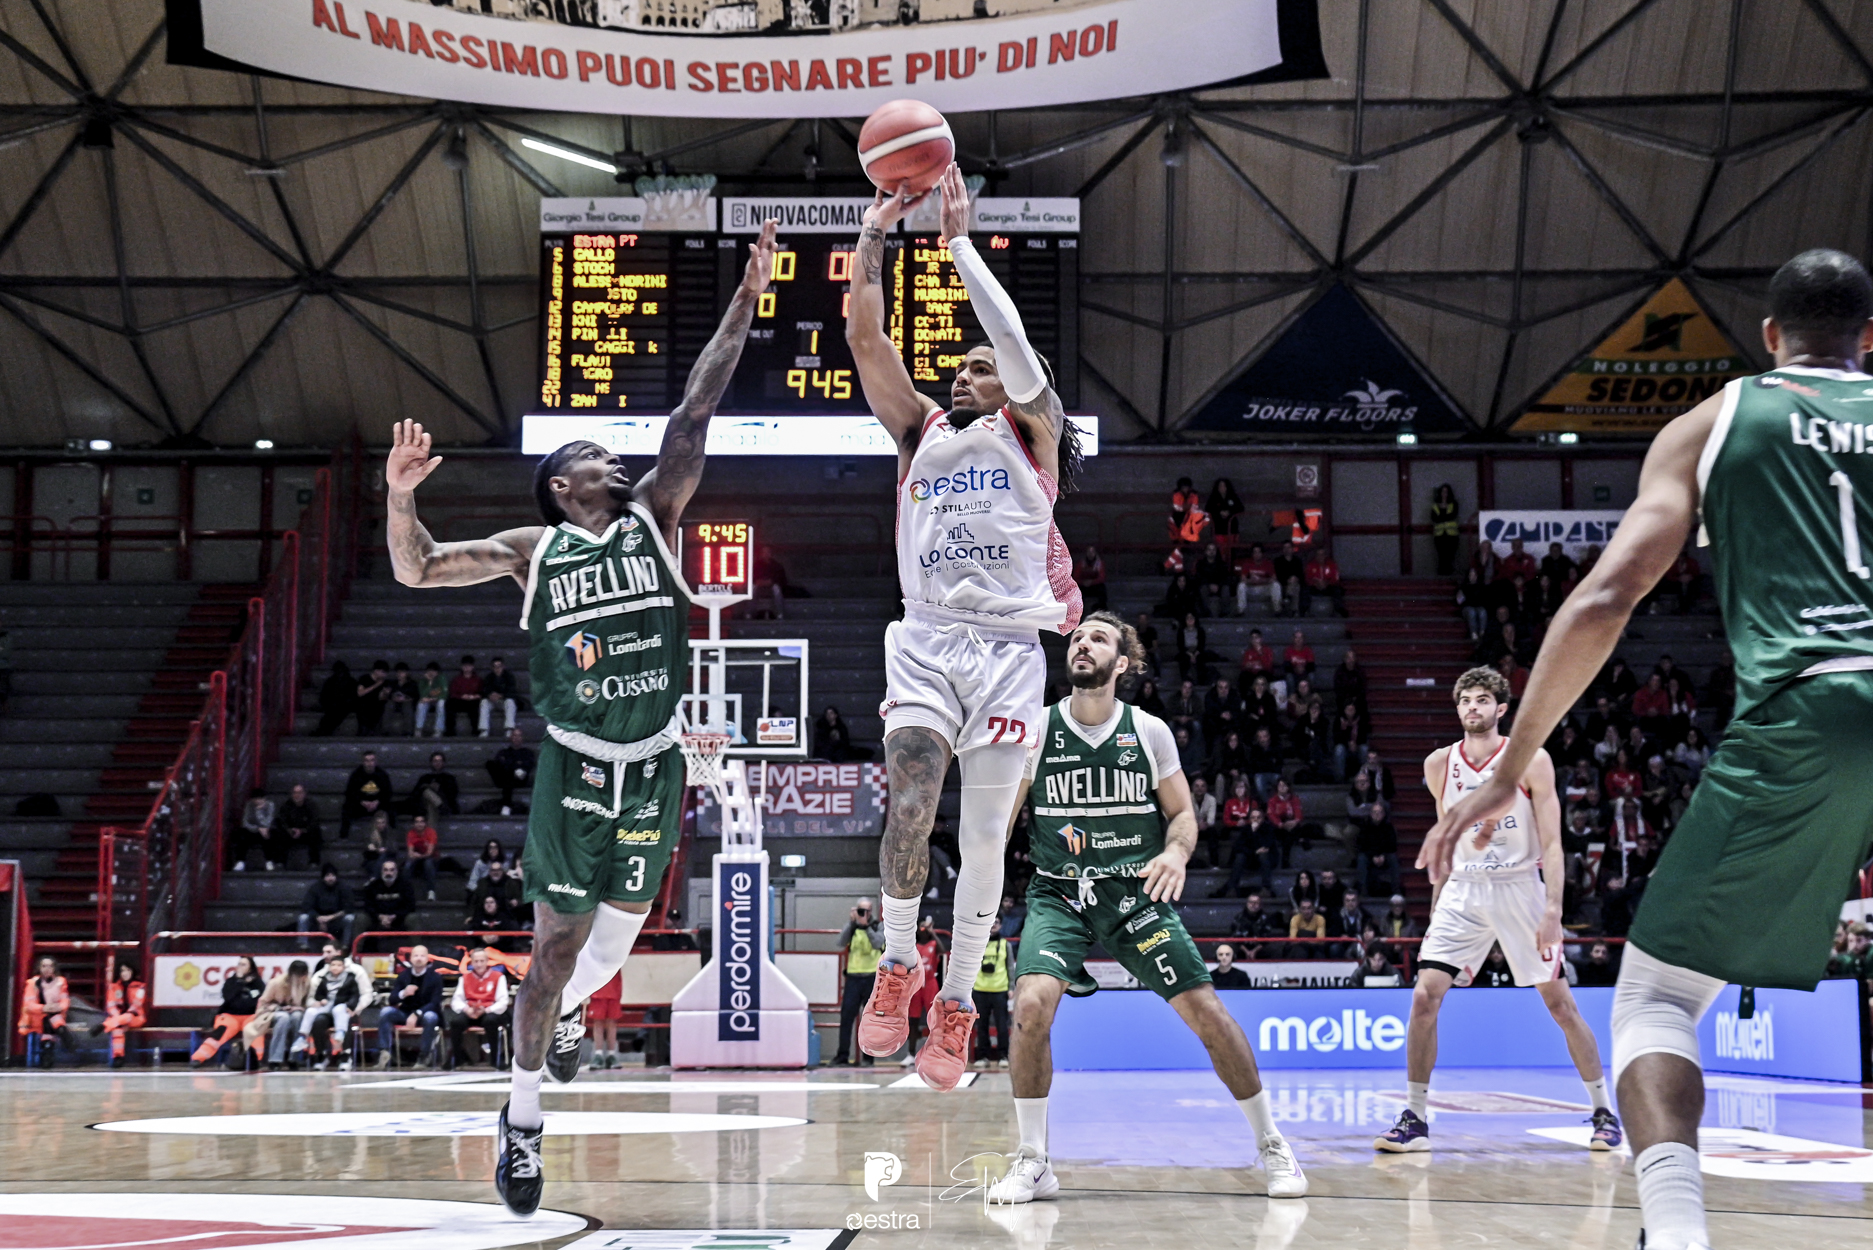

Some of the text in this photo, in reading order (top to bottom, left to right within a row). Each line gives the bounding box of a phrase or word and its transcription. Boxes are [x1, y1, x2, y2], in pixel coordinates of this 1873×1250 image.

[313, 0, 361, 40] AL
[365, 11, 568, 80] MASSIMO
[576, 50, 676, 91] PUOI
[687, 55, 893, 93] SEGNARE
[996, 37, 1038, 73] DI
[1048, 20, 1119, 65] NOI
[543, 211, 641, 224] Giorgio Tesi Group
[978, 211, 1077, 224] Giorgio Tesi Group
[573, 235, 616, 248] ESTRA
[619, 234, 638, 247] PT
[573, 248, 615, 261] GALLO
[573, 261, 615, 274] STOCH
[758, 293, 776, 318] 0
[810, 330, 818, 355] 1
[1593, 359, 1731, 374] NOLEGGIO
[1243, 404, 1418, 422] JOKER FLOORS
[933, 466, 1011, 496] estra
[942, 500, 992, 513] STILAUTO
[699, 523, 747, 542] 9:45
[1829, 470, 1871, 580] 1
[703, 546, 745, 583] 10
[919, 544, 1009, 568] LO CONTE
[549, 556, 660, 614] AVELLINO
[608, 634, 662, 656] Lombardi
[601, 674, 669, 700] CUSANO
[1054, 731, 1065, 749] 5
[747, 765, 858, 787] EMPRE
[1452, 763, 1461, 779] 5
[1045, 767, 1148, 804] AVELLINO
[761, 785, 852, 814] RAZIE
[1091, 834, 1142, 849] Lombardi
[625, 855, 646, 892] 3
[724, 872, 755, 1032] perdormire
[1154, 953, 1178, 986] 5
[1259, 1009, 1408, 1053] molte
